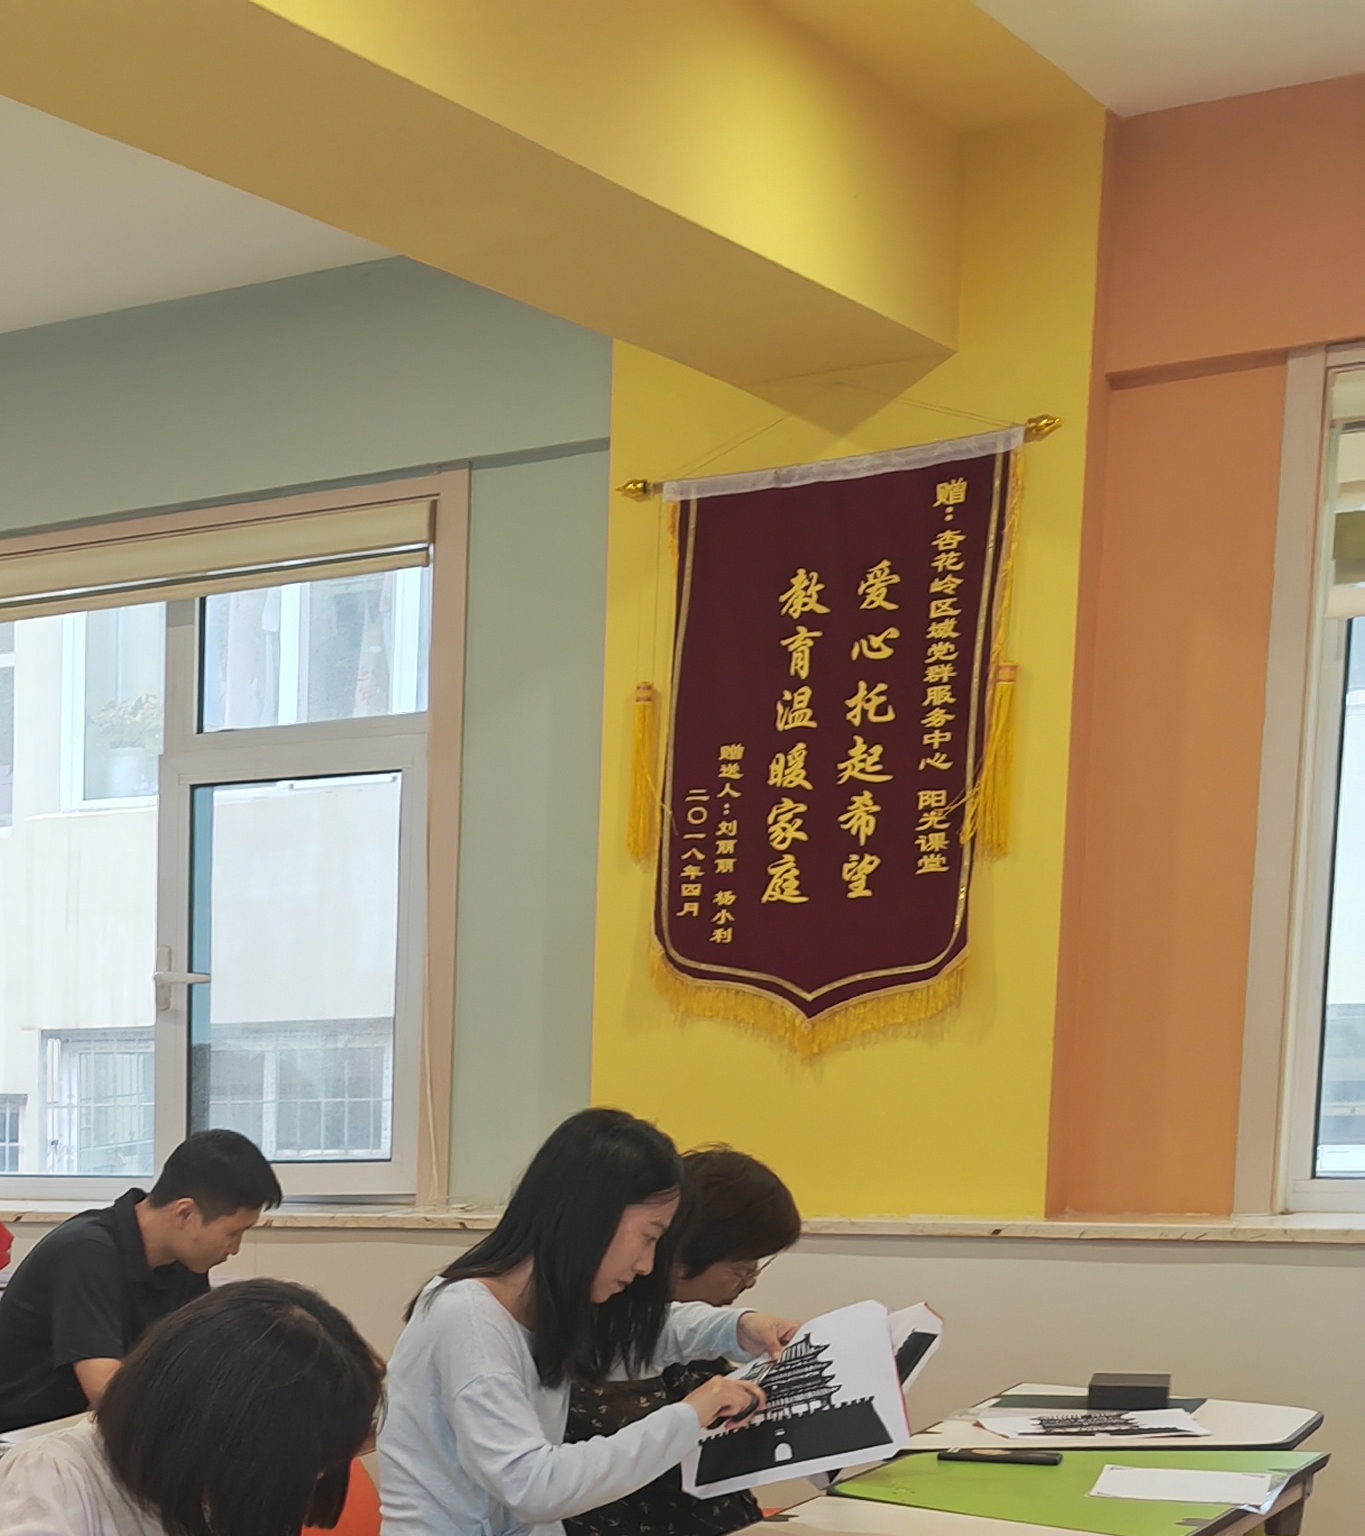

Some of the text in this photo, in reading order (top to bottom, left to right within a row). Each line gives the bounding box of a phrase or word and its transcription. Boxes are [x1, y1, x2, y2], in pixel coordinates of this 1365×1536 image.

[761, 568, 831, 904] 教育温暖家庭
[836, 559, 901, 899] 爱心托起希望
[915, 789, 952, 875] 阳光课堂
